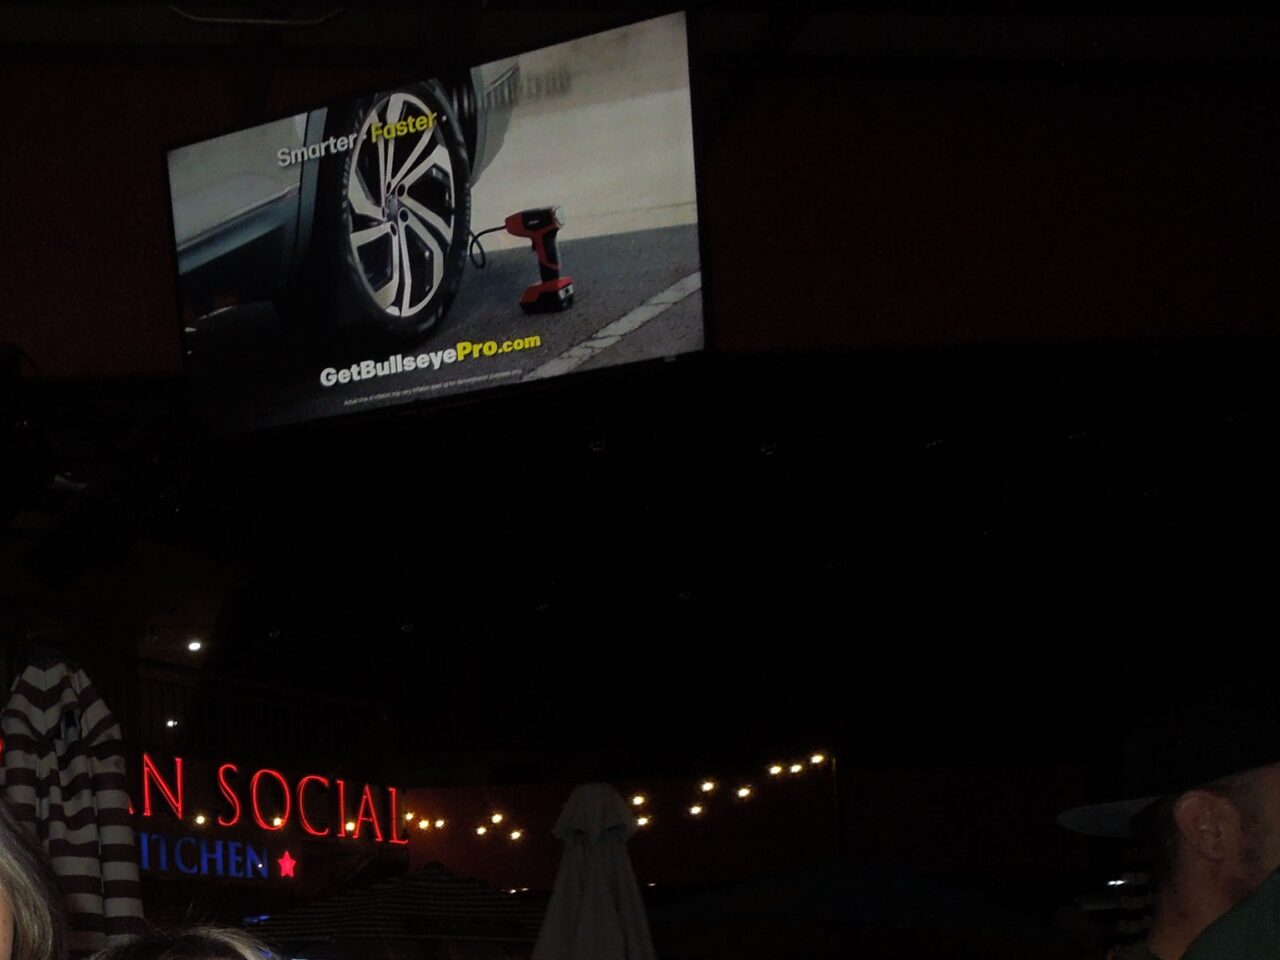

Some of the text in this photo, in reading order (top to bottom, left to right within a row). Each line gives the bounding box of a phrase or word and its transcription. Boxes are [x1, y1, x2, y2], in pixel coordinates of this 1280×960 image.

[276, 111, 438, 168] Smarter Faster
[320, 334, 542, 388] GetBullseyePro.com
[216, 762, 409, 844] SOCIAL
[136, 830, 270, 880] ITCHEN
